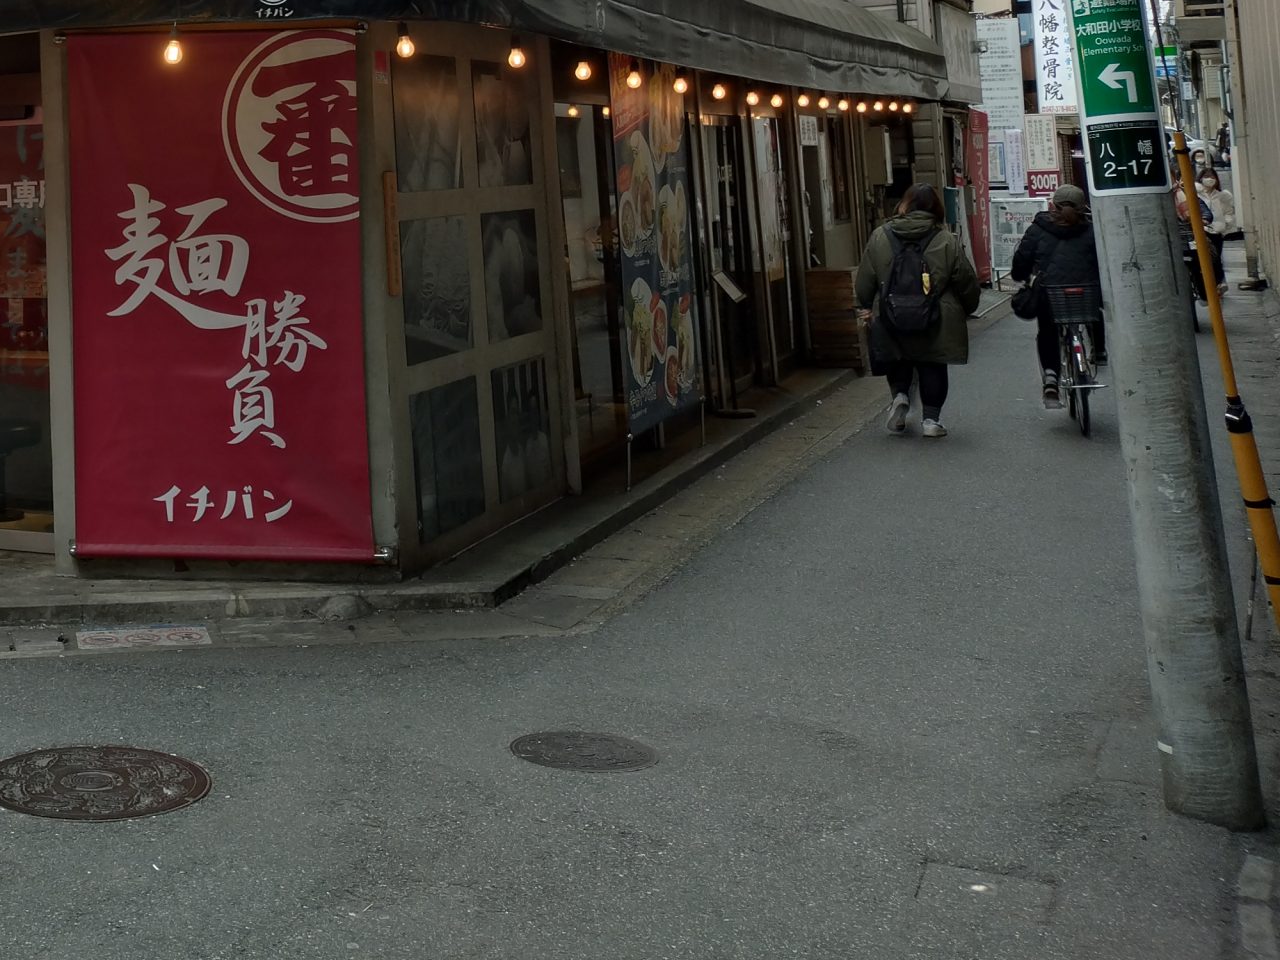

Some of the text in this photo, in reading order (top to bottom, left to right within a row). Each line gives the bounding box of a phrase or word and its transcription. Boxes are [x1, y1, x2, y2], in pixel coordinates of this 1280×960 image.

[255, 7, 294, 18] イチバン
[1076, 19, 1142, 37] 大和田小学校
[1095, 35, 1131, 46] Oowada
[1083, 45, 1131, 57] Elementary
[1099, 139, 1153, 158] 八幡
[1103, 159, 1153, 178] 2-17
[104, 184, 328, 450] 麺勝負
[153, 484, 293, 523] イチバン
